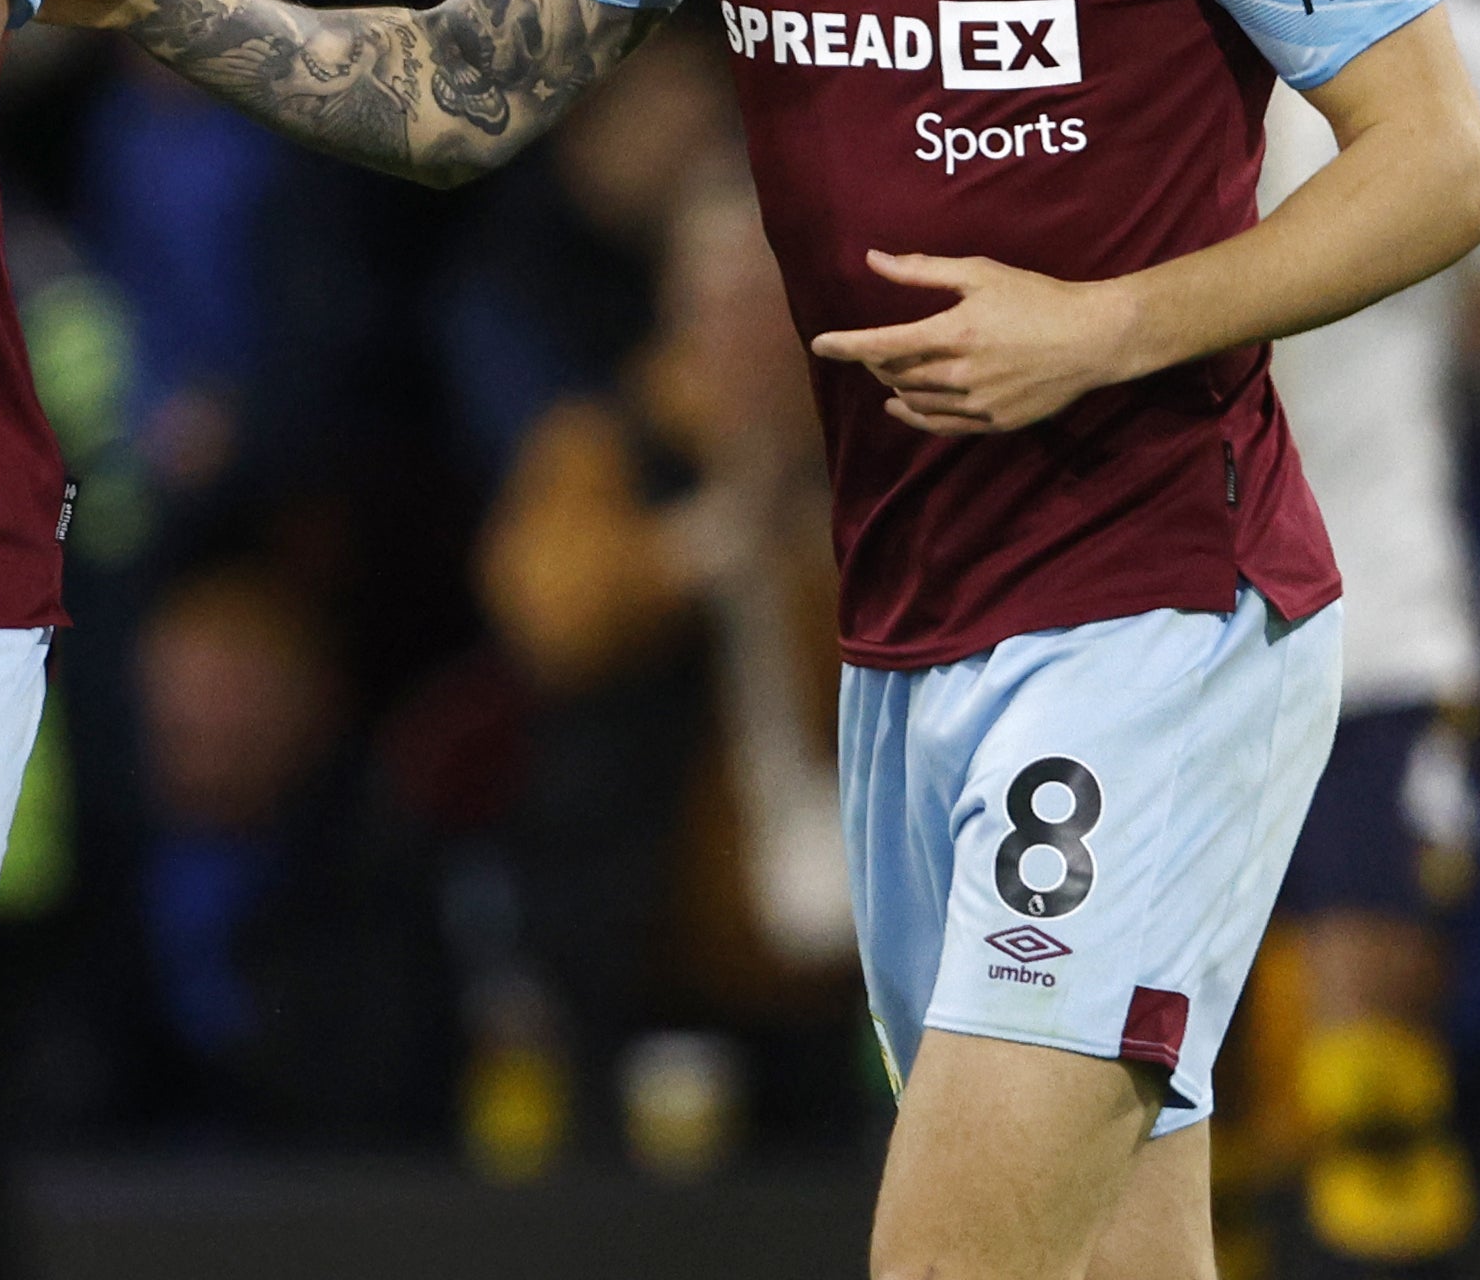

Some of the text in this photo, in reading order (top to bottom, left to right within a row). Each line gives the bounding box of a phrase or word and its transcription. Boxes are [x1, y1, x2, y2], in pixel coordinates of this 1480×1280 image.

[914, 111, 1088, 175] Sports
[994, 754, 1103, 918] 8
[988, 964, 1056, 987] umbro
